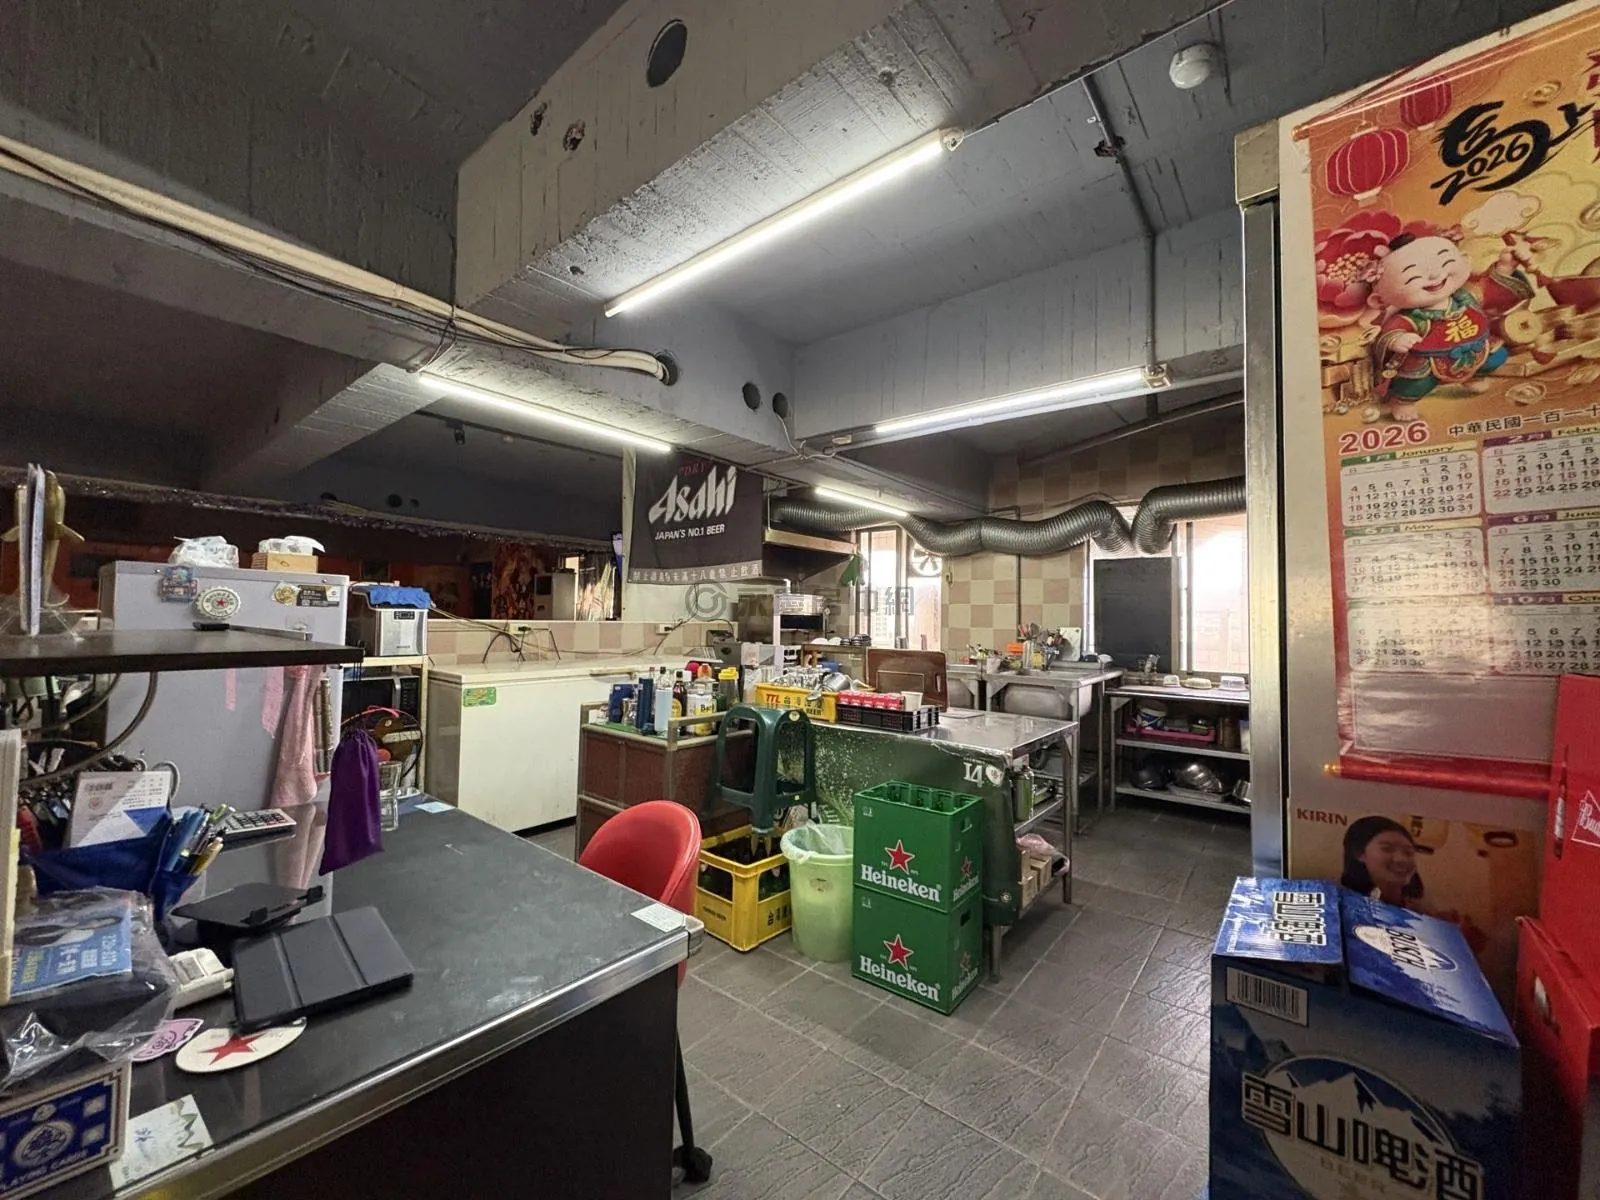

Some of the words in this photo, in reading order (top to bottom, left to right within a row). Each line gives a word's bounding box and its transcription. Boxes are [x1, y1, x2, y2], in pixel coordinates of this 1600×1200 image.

[1430, 134, 1530, 206] 2026
[1445, 316, 1479, 343] 福
[1340, 421, 1429, 454] 2026
[648, 465, 737, 524] Asahi
[655, 529, 686, 541] JAPAN'S
[688, 528, 704, 537] NO.1
[707, 524, 725, 535] BEER
[1297, 808, 1348, 826] KIRIN
[861, 864, 941, 903] Heineken
[1387, 927, 1428, 970] BUSCH
[859, 955, 940, 1002] Heineken
[1243, 1073, 1482, 1200] 雪山啤酒
